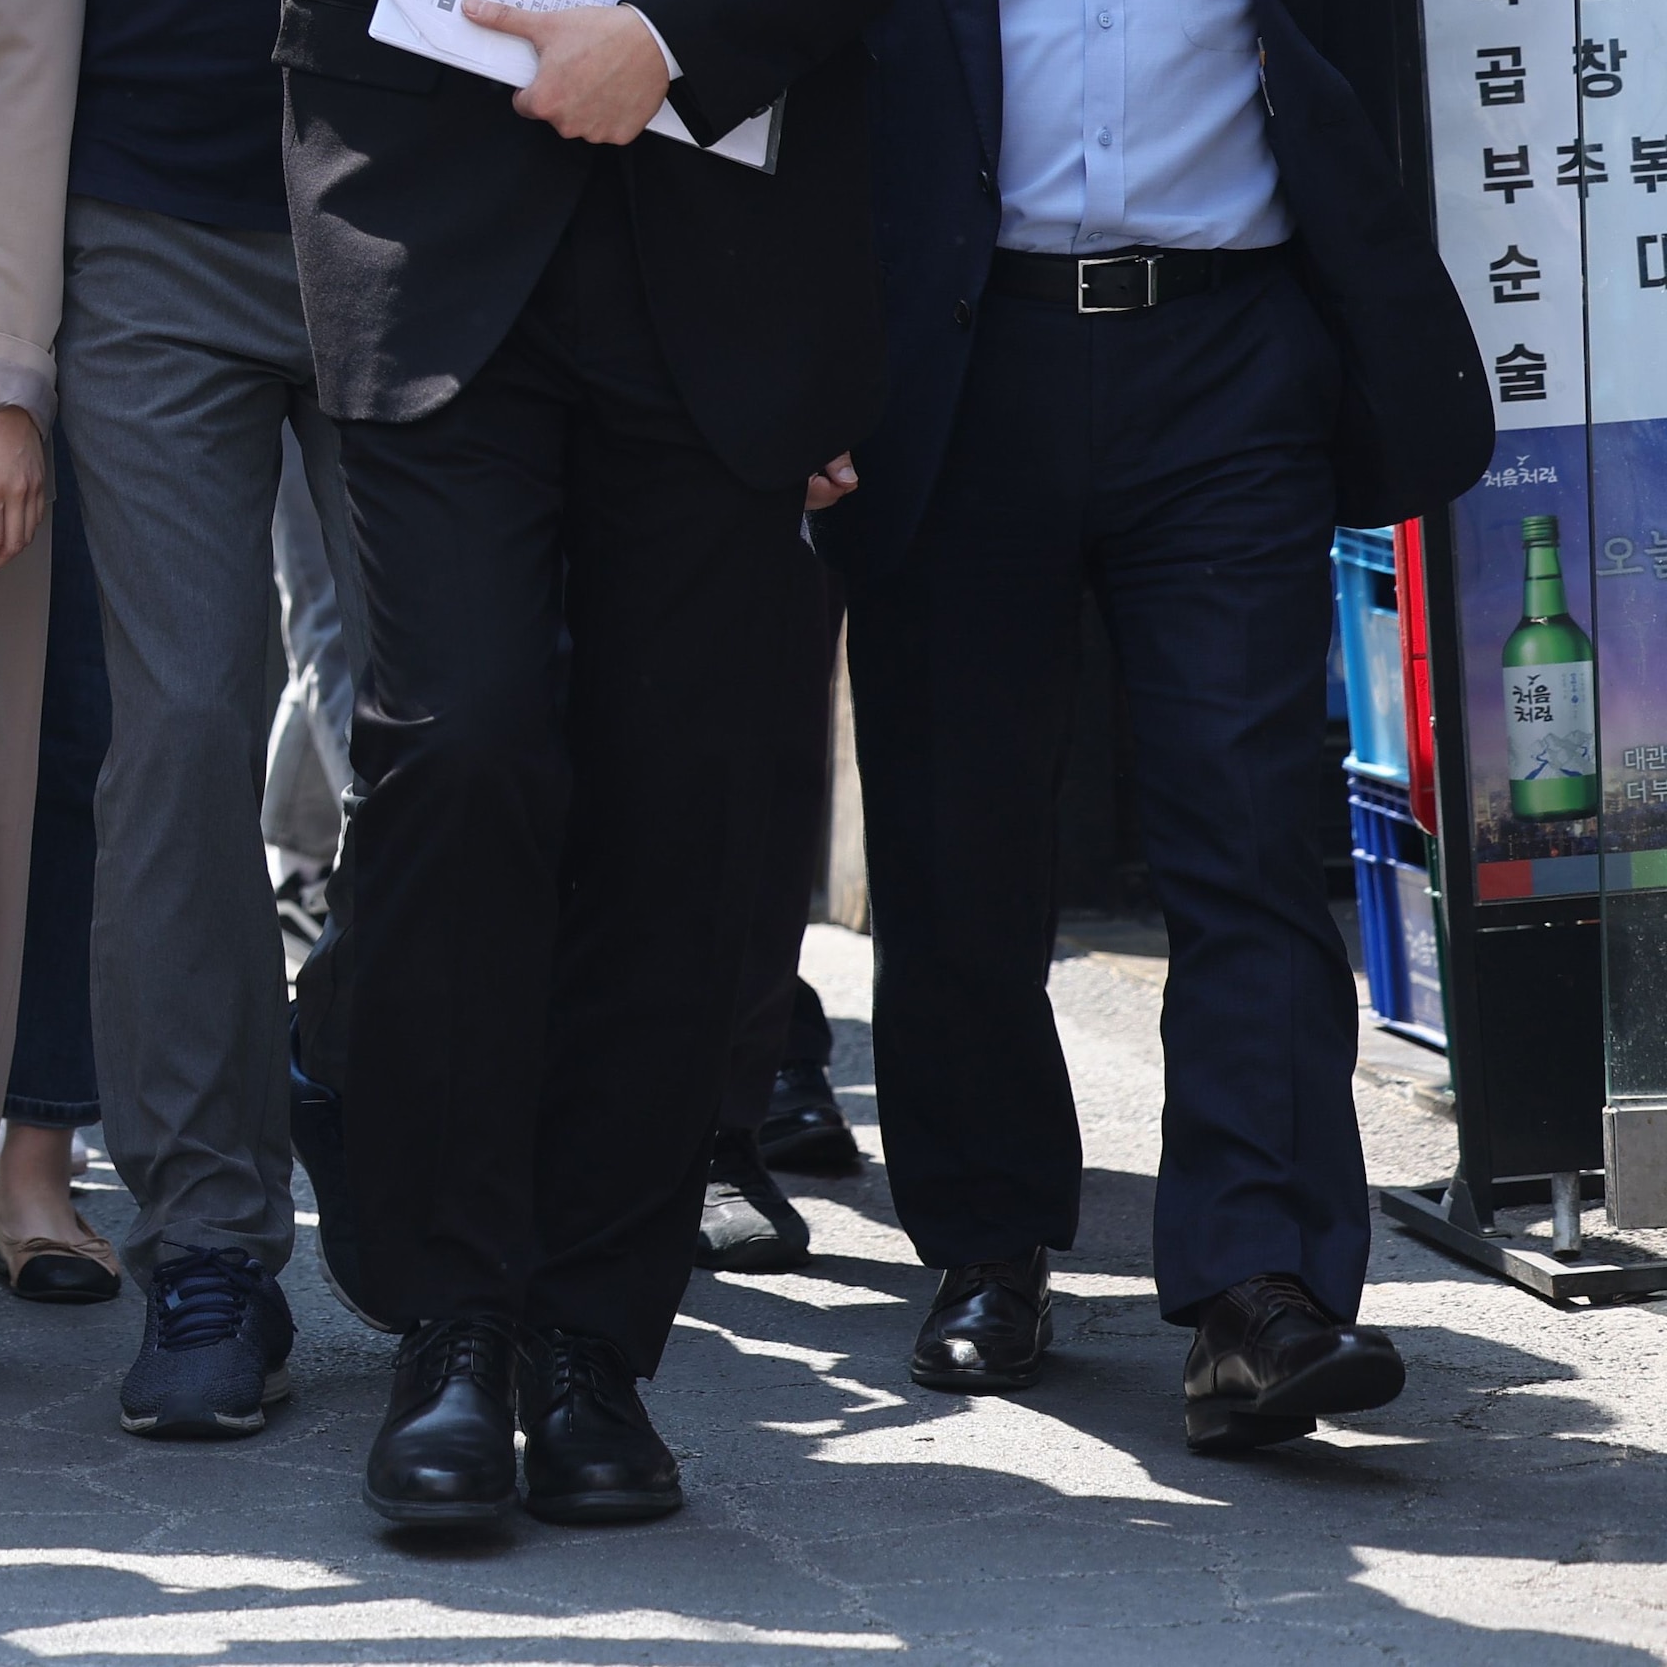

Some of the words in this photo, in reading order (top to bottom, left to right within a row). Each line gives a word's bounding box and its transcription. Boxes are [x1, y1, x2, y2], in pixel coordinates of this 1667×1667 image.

[1475, 45, 1527, 107] 곱
[1483, 145, 1534, 204] 부
[1489, 244, 1541, 304] 순
[1495, 343, 1547, 403] 술
[1483, 466, 1559, 488] 처음처럼
[1513, 685, 1552, 705] 처음
[1514, 705, 1554, 724] 처럼
